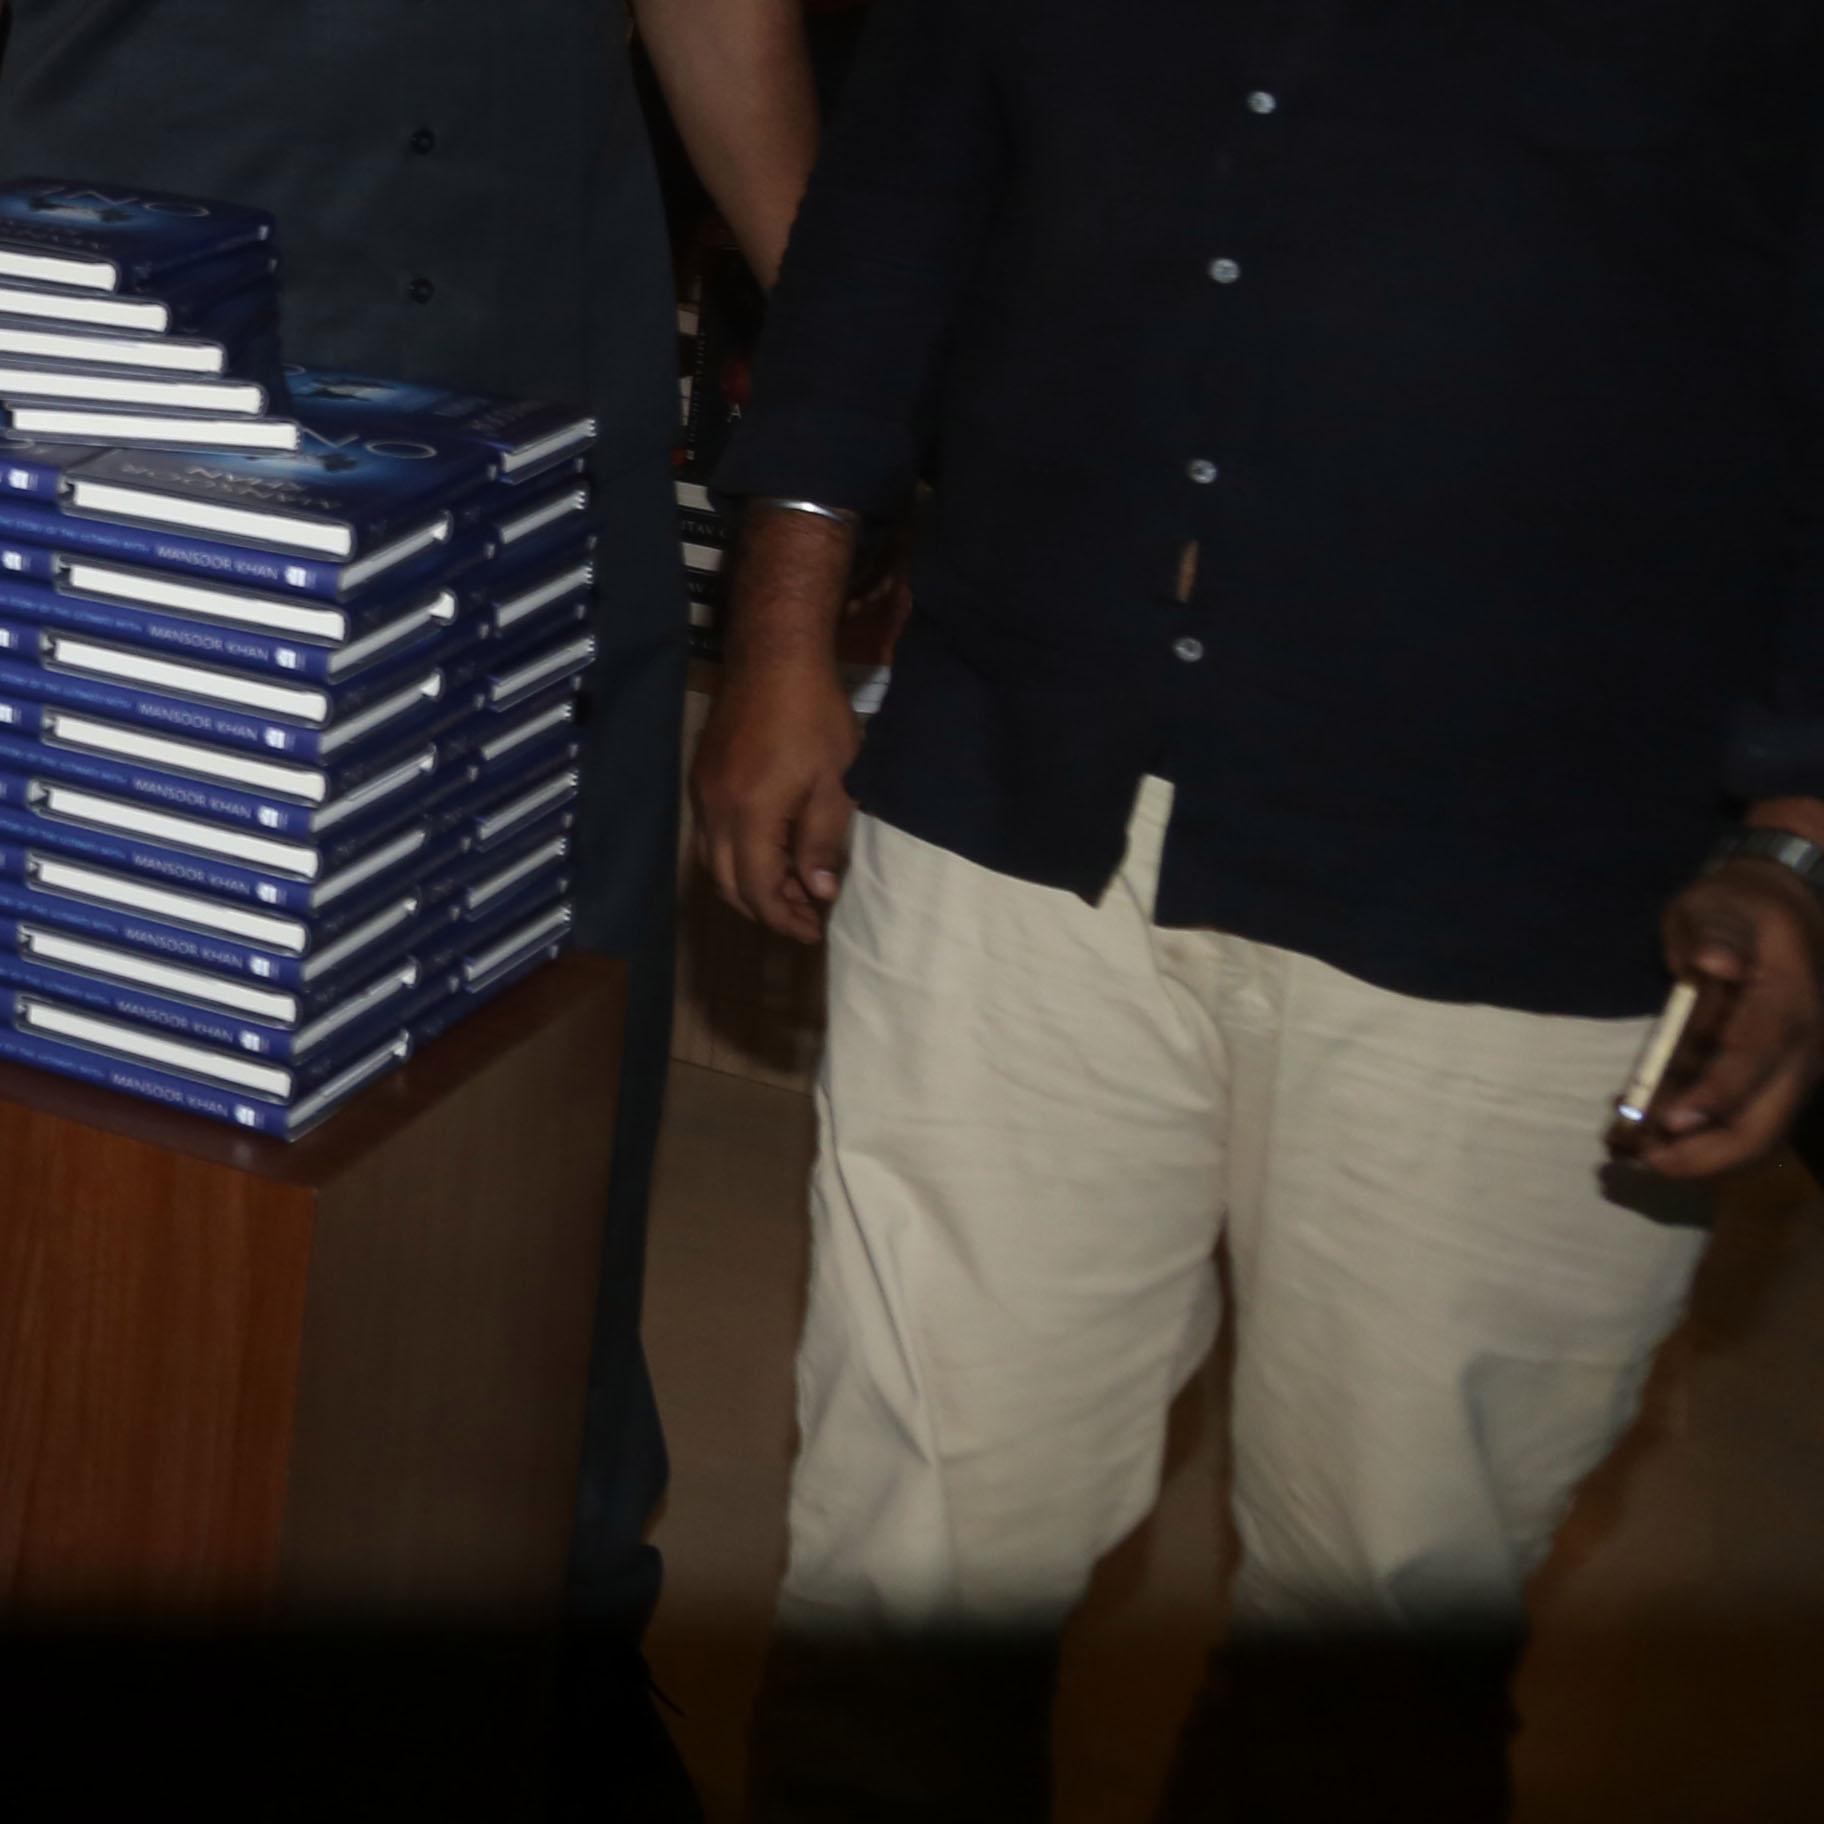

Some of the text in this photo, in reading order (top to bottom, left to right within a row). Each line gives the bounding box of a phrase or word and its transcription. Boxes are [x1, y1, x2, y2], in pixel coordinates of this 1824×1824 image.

[156, 545, 232, 573] MANSOOR
[235, 557, 279, 581] KHAN
[148, 623, 223, 651] MANSOOR
[226, 637, 270, 661] KHAN
[138, 701, 212, 730] MANSOOR
[215, 716, 258, 741] KHAN
[134, 779, 208, 808] MANSOOR
[210, 796, 252, 821] KHAN
[132, 852, 205, 882] MANSOOR
[207, 870, 250, 896] KHAN
[124, 925, 198, 958] MANSOOR
[200, 943, 243, 970] KHAN
[117, 998, 189, 1029] MANSOOR
[191, 1017, 234, 1044] KHAN
[112, 1072, 184, 1104] MANSOOR
[185, 1091, 229, 1119] KHAN
